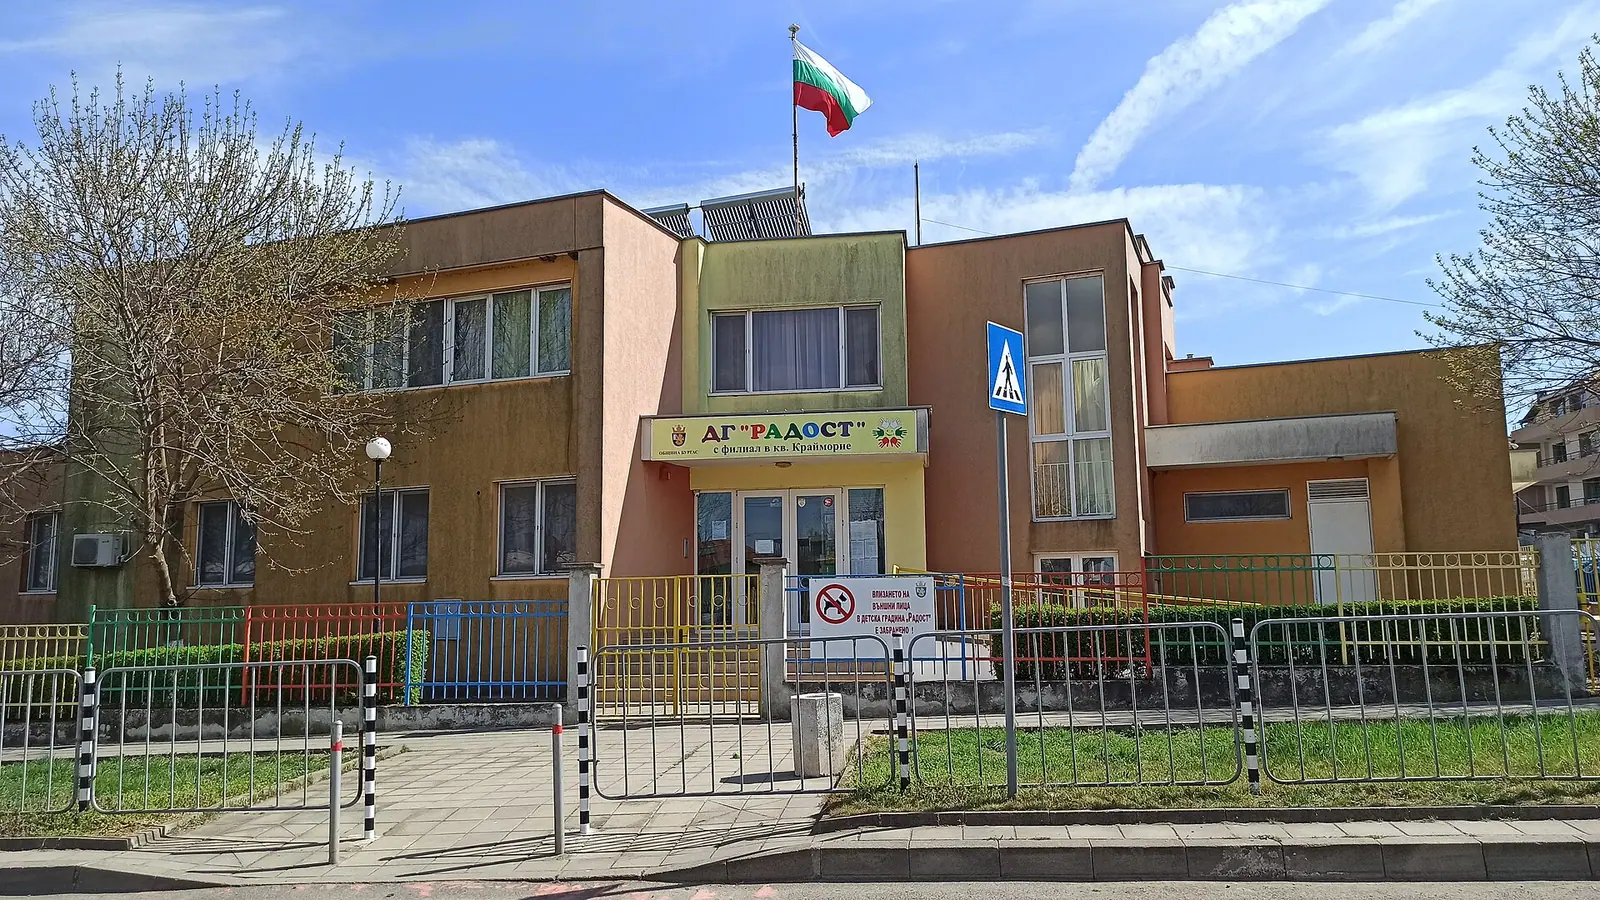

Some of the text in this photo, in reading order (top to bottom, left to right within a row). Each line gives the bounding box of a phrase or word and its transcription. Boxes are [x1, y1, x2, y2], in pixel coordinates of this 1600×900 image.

[721, 445, 761, 455] филиал
[764, 445, 771, 453] в
[773, 445, 789, 453] кв.
[792, 443, 852, 453] Крайморие
[872, 590, 910, 598] ВЛИЗАНЕТО НА
[872, 602, 911, 611] ВЪНШНИ ЛИЦА
[861, 614, 881, 624] ДЕТСКА
[882, 614, 906, 624] ГРАДИНА
[880, 626, 910, 635] ЗАБРАНЕНО
